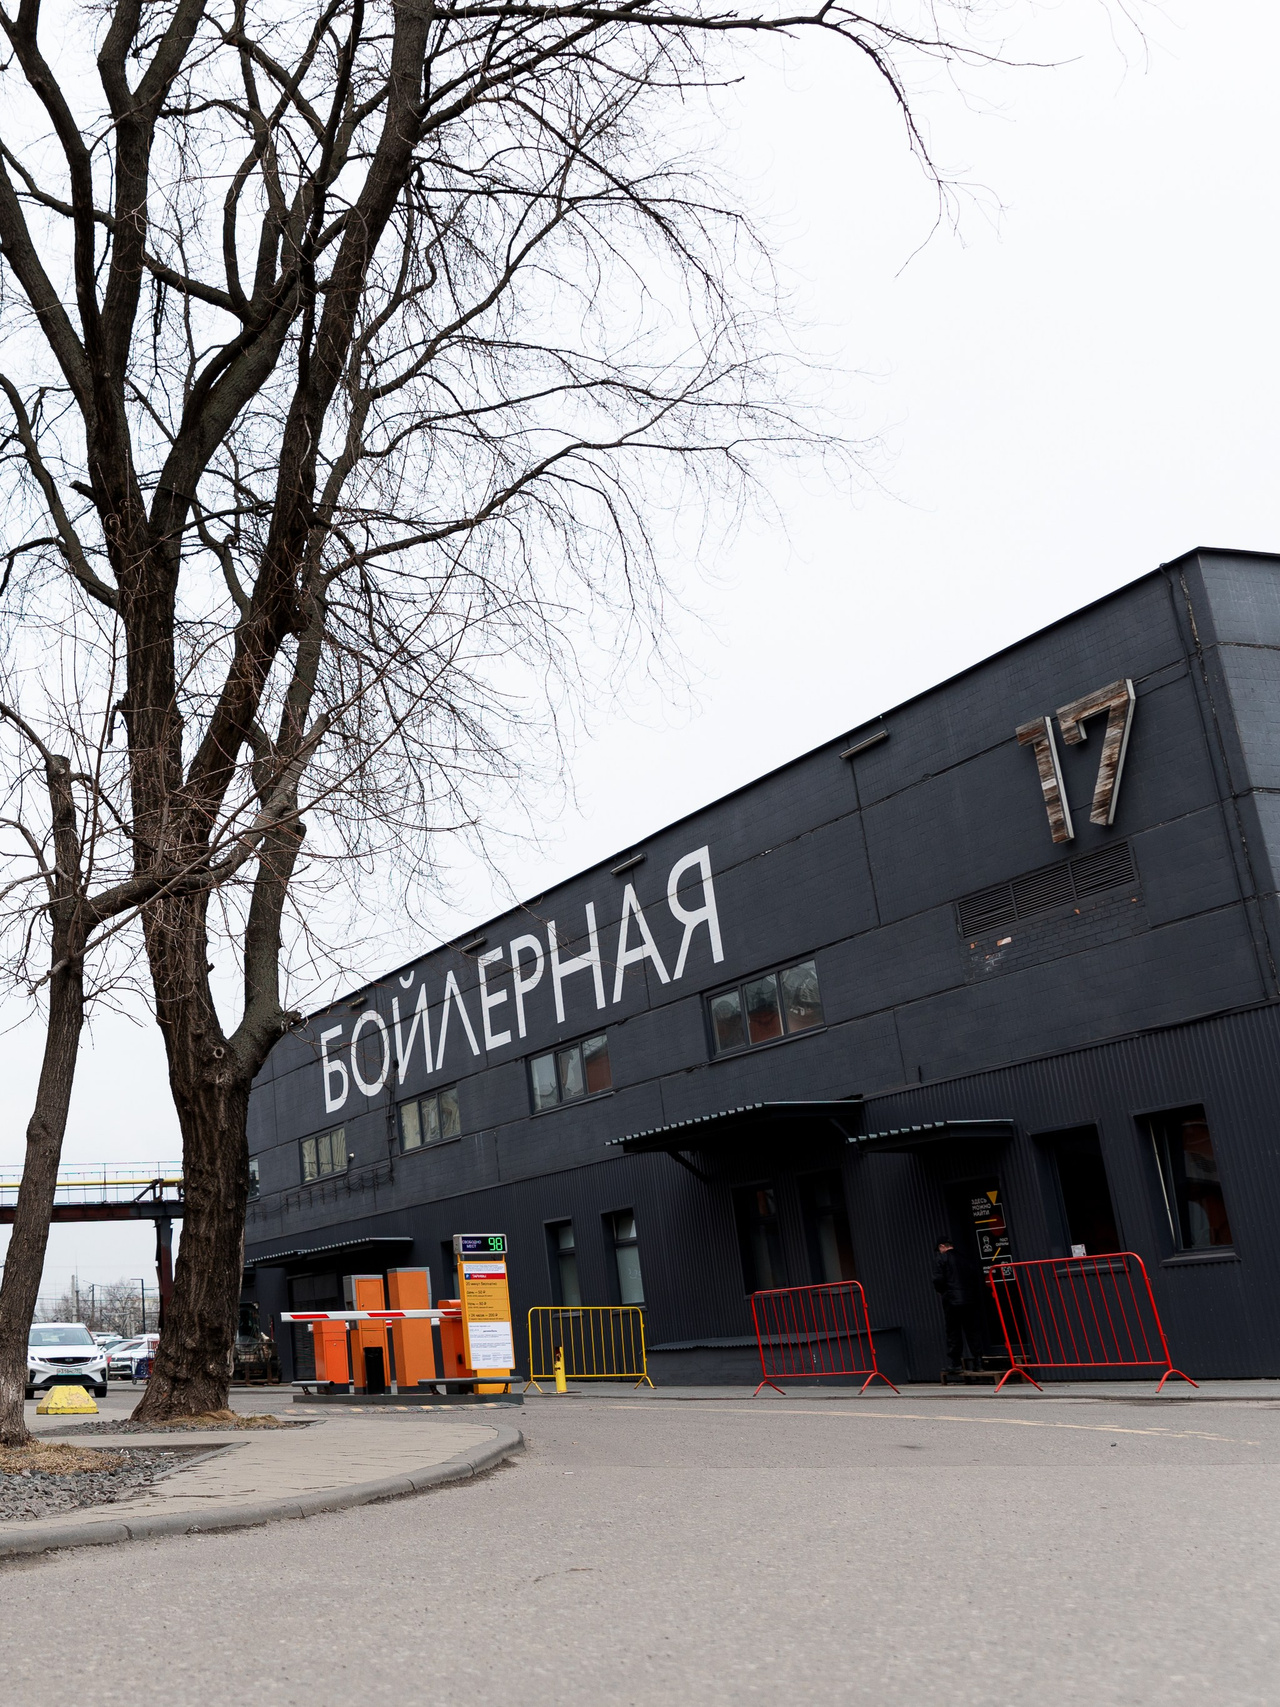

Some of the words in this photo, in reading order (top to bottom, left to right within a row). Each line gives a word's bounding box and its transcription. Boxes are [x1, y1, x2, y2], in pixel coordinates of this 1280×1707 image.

[1015, 679, 1136, 843] 17
[320, 845, 724, 1113] БОЙЛЕРНАЯ
[488, 1237, 503, 1251] 98
